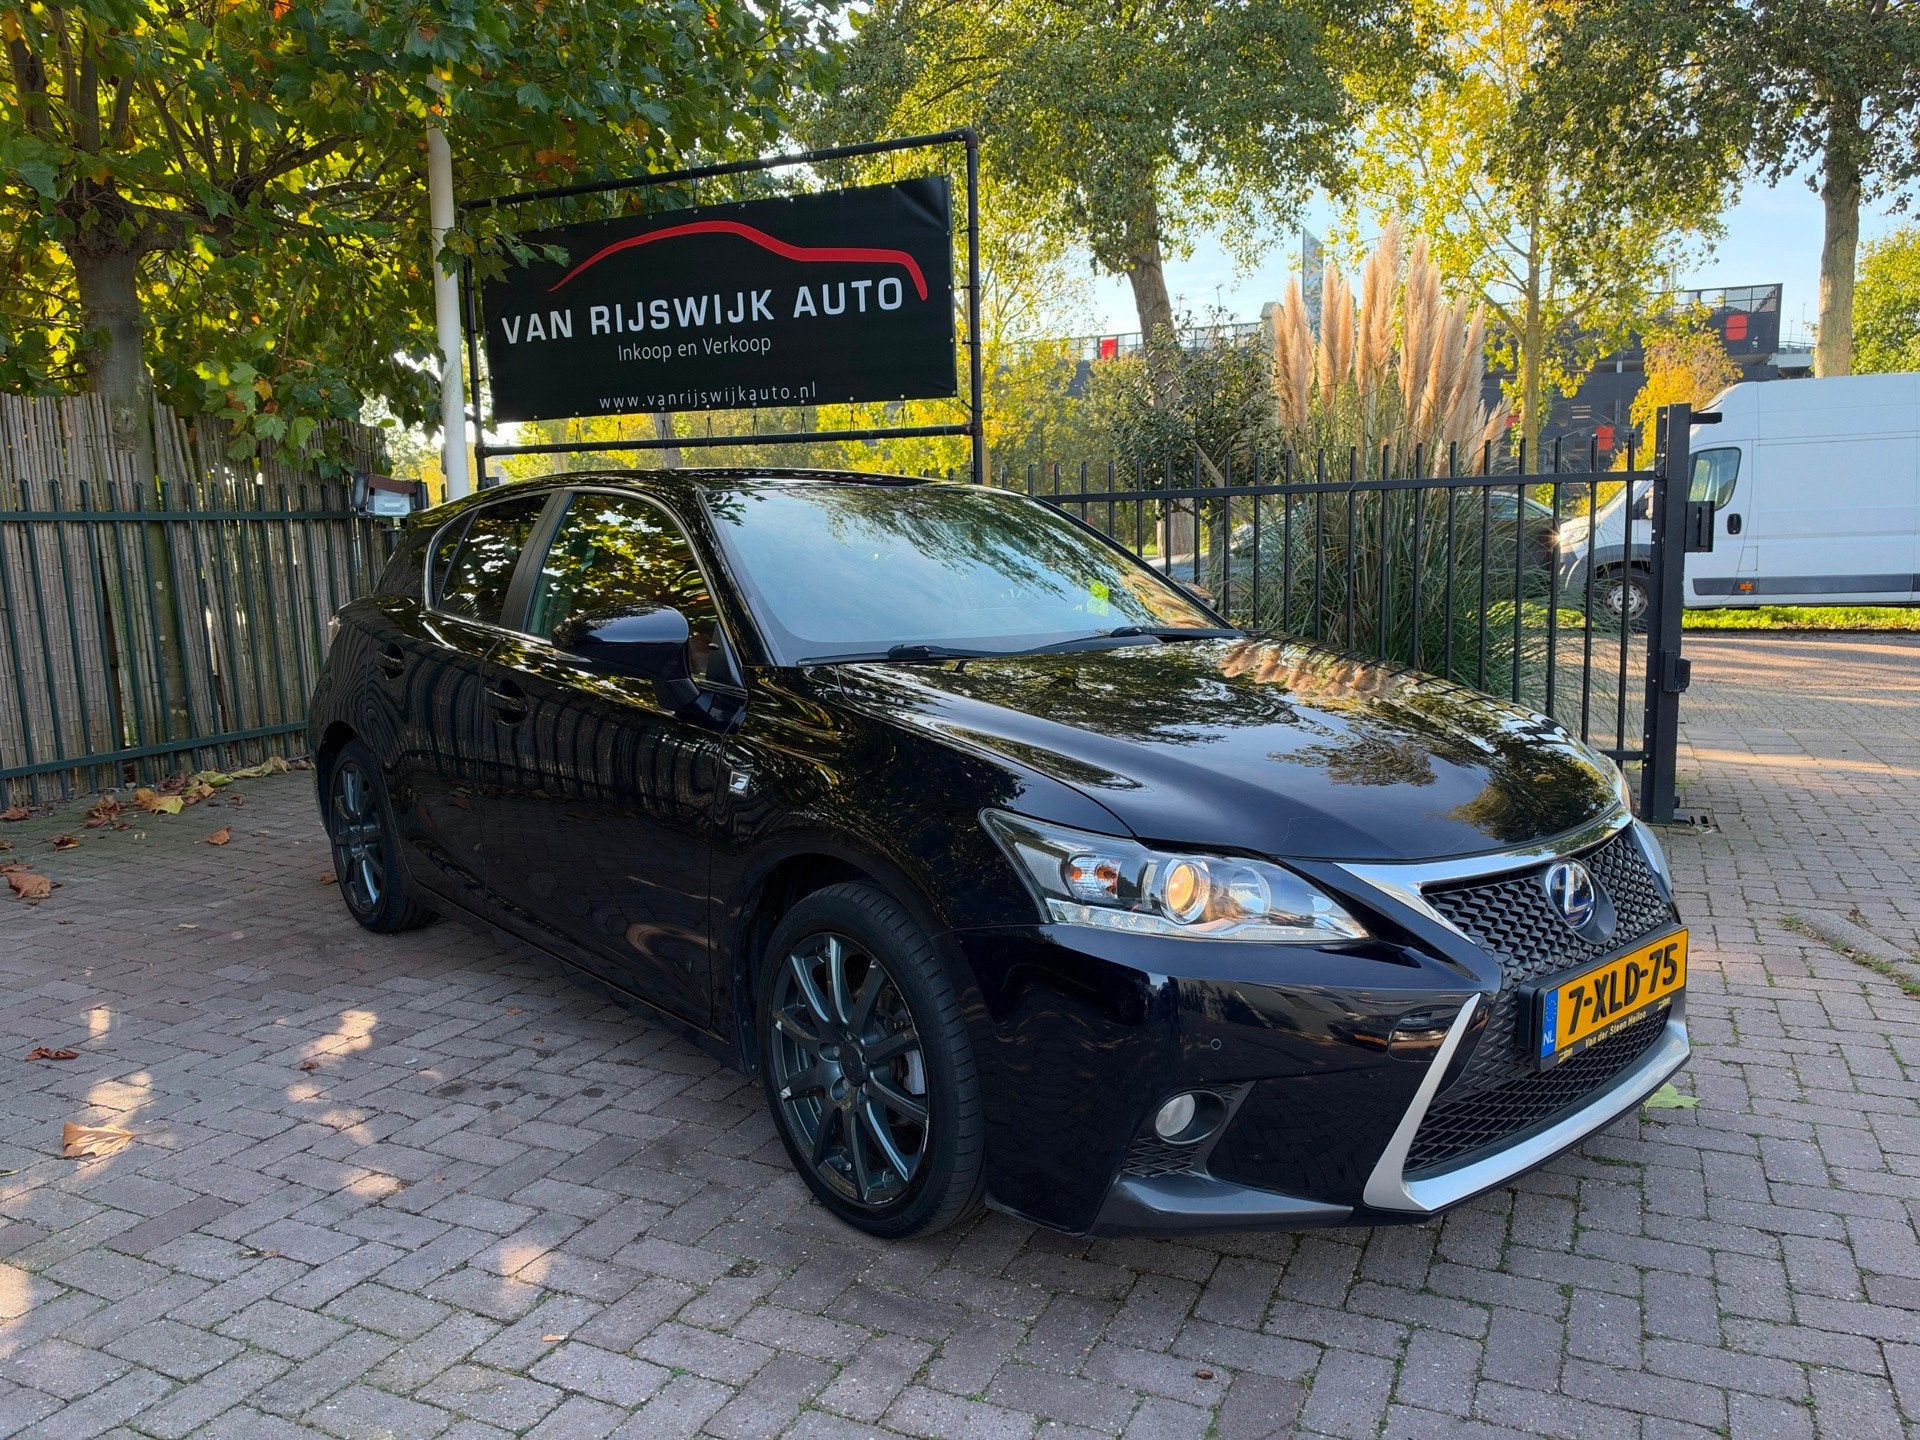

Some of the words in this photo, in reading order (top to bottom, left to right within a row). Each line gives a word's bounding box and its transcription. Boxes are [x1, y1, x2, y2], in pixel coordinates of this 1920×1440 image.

[501, 309, 573, 345] VAN
[589, 288, 775, 336] RIJSWIJK
[793, 276, 903, 319] AUTO
[618, 342, 672, 363] Inkoop
[678, 342, 697, 357] en
[703, 335, 771, 356] Verkoop
[599, 381, 816, 409] www.vanrijswijkauto.nl
[1568, 943, 1678, 1035] 7-XLD-75
[1542, 1031, 1555, 1047] NL
[1585, 1036, 1597, 1049] Van
[1597, 1030, 1609, 1042] der
[1609, 1020, 1628, 1035] Steen
